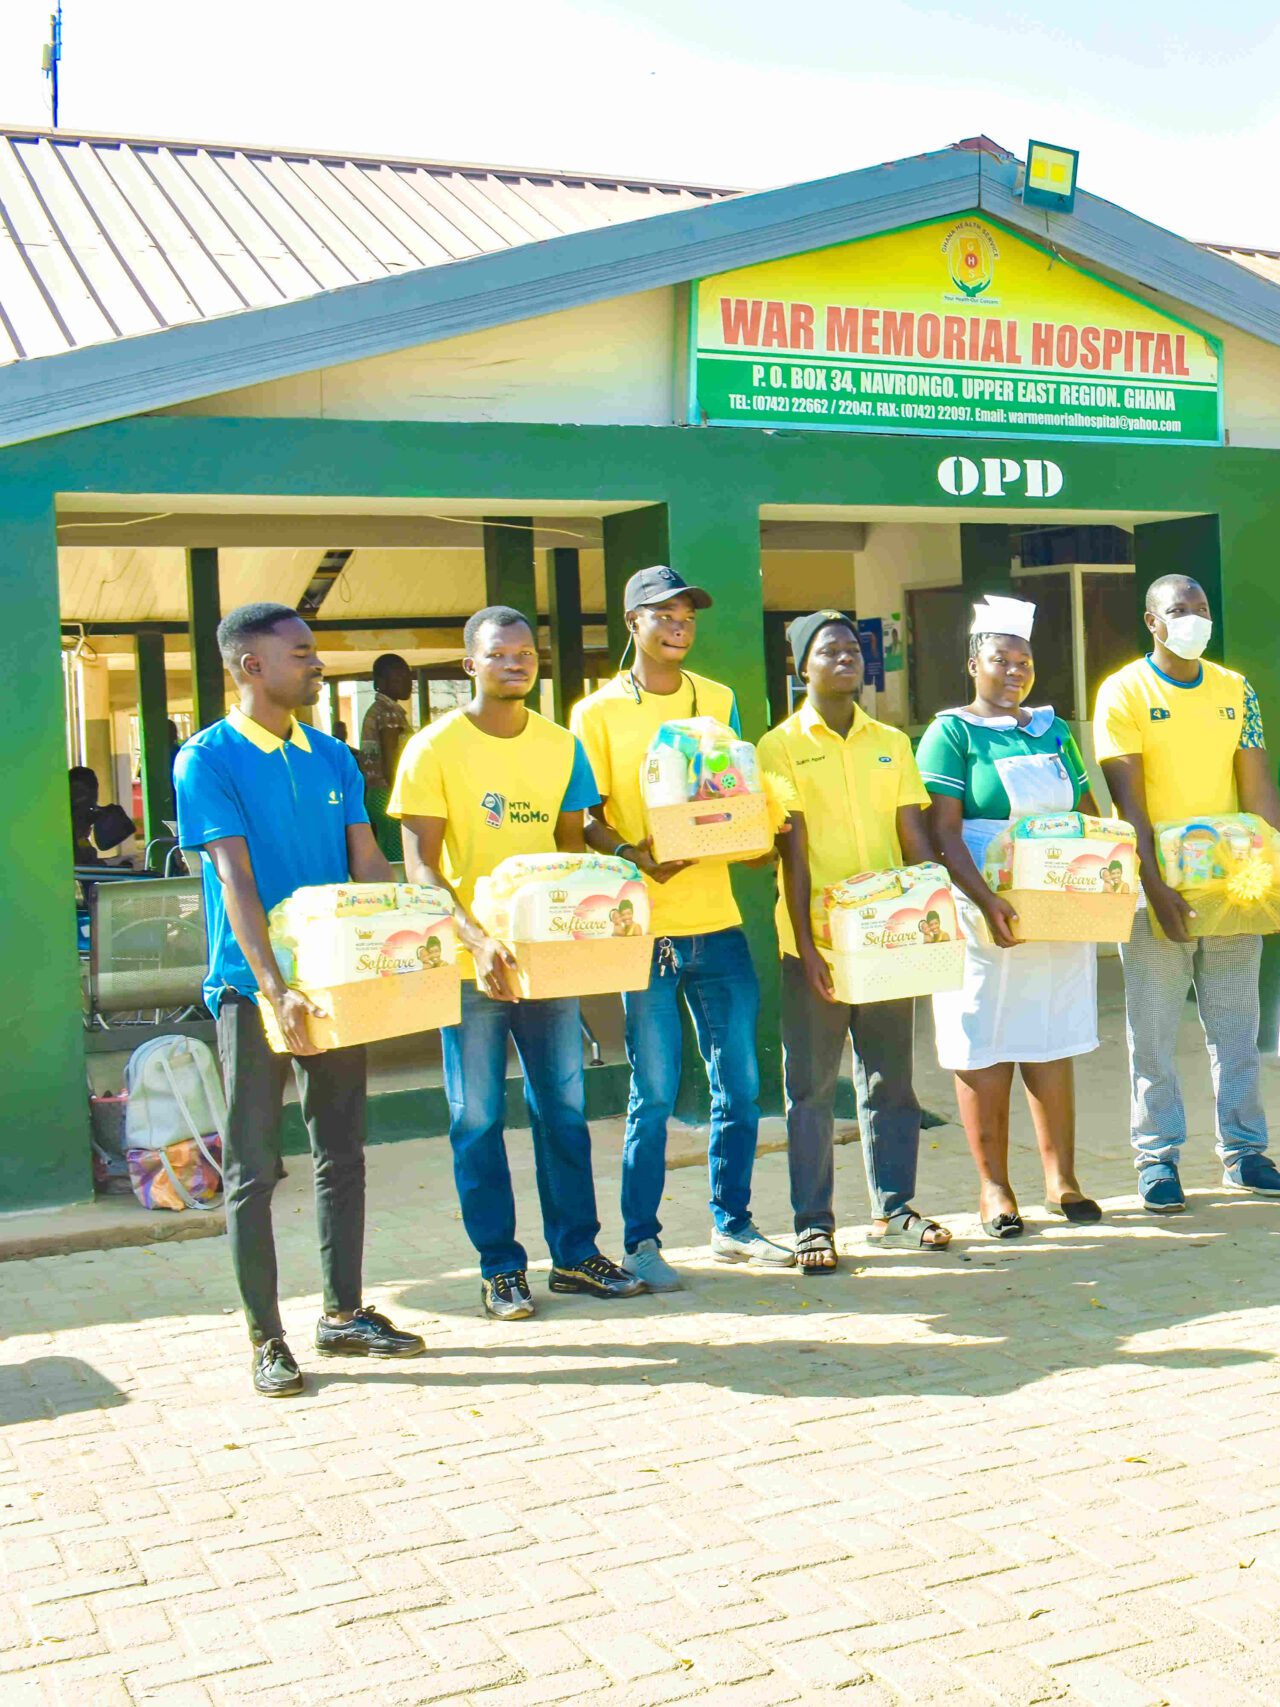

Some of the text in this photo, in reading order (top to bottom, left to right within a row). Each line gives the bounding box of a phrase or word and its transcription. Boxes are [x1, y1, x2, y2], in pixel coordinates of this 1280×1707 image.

[956, 222, 981, 231] HEALTH
[982, 229, 999, 257] SERVICE
[967, 256, 976, 266] H
[720, 298, 1190, 377] WAR MEMORIAL HOSPITAL
[752, 364, 1176, 411] P. O. BOX 34, NAVRONGO. UPPER EAST REGION. GHANA
[728, 393, 1182, 432] TEL: (0742) 22662 / 22047. FAX: (0742) 22097. Email: warmemorialhospital@yahoo.com
[937, 456, 1064, 498] OPD
[508, 801, 531, 810] MTN
[509, 811, 550, 823] MoMo
[1043, 870, 1097, 889] Softcare
[548, 916, 607, 934] Softcare
[862, 928, 917, 948] Softcare
[356, 953, 417, 975] Softcare
